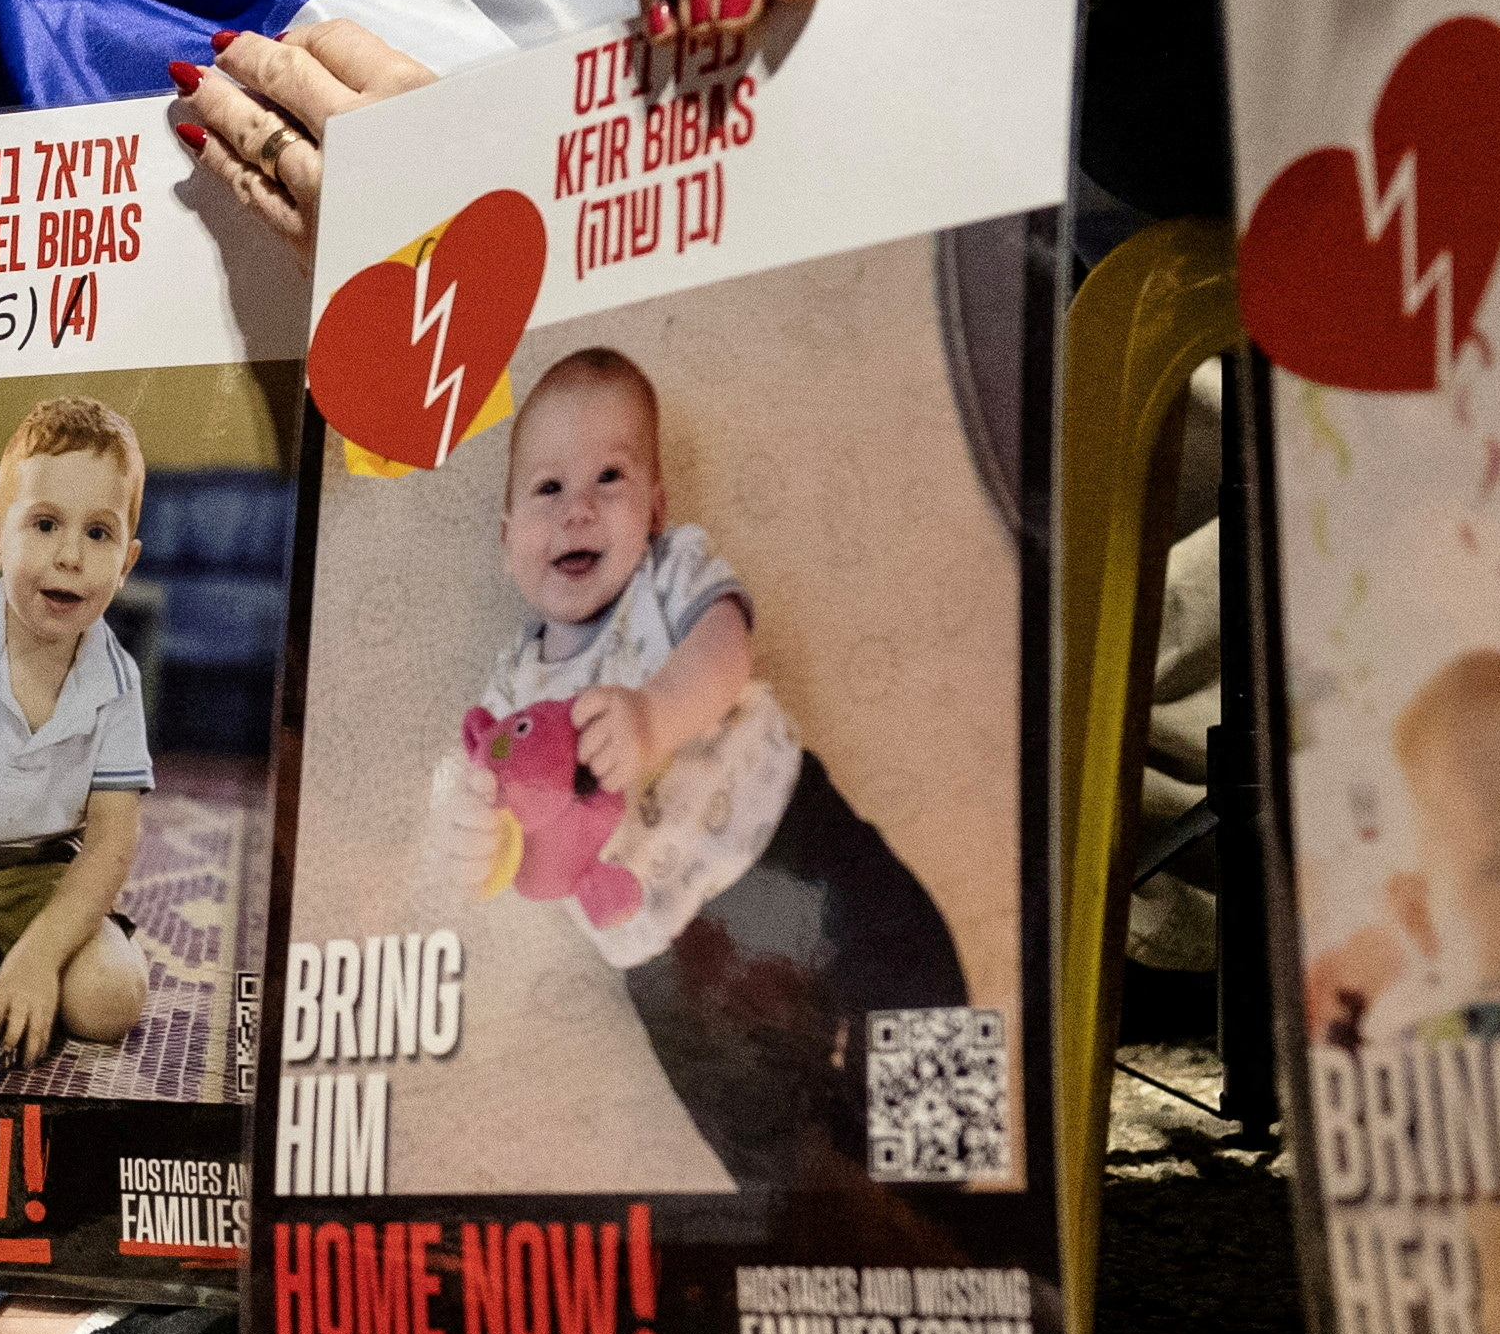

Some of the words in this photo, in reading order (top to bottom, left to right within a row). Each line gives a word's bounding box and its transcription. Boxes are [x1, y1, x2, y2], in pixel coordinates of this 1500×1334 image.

[34, 134, 140, 202] אריאל
[554, 115, 630, 201] KFIR
[642, 75, 757, 174] BIBAS
[37, 202, 142, 269] BIBAS
[282, 928, 464, 1063] BRING
[274, 1071, 388, 1197] HIM
[119, 1157, 222, 1196] HOSTAGES
[226, 1162, 251, 1199] AN
[121, 1193, 251, 1249] FAMILIES
